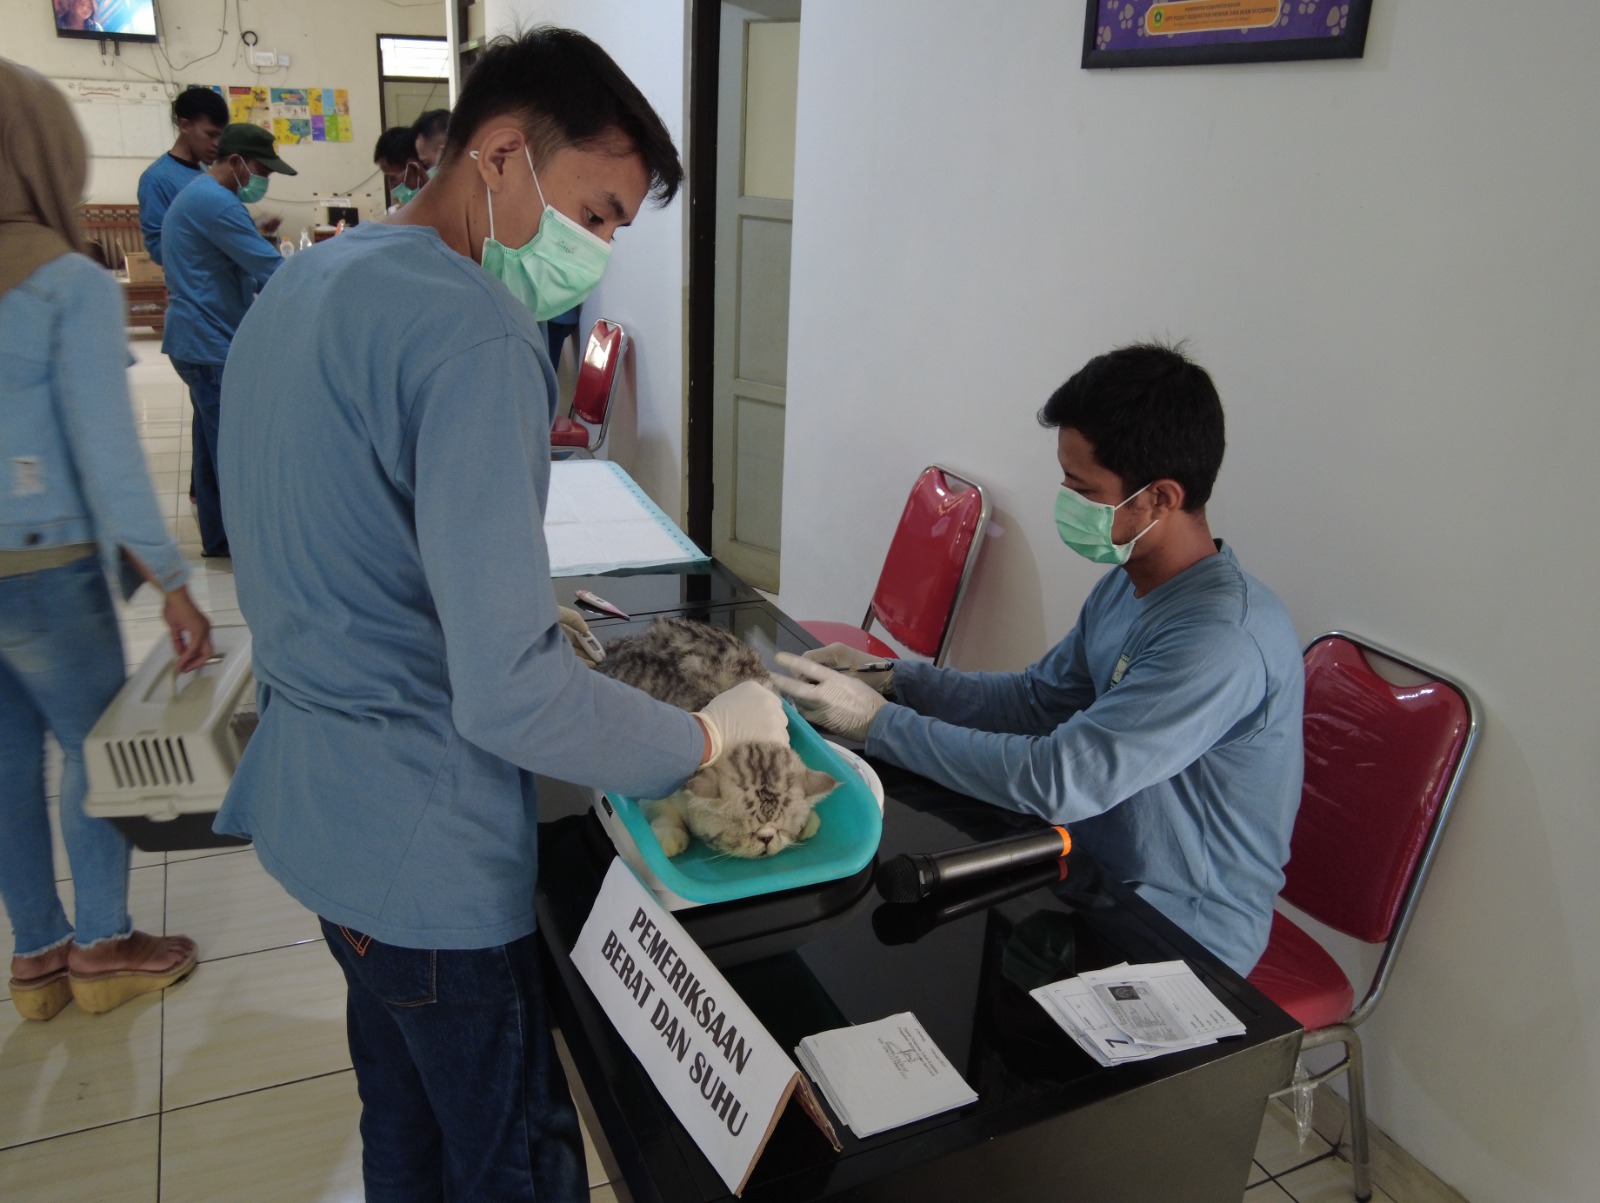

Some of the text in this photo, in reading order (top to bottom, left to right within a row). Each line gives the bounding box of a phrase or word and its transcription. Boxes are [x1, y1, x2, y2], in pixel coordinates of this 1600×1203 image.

[601, 930, 749, 1137] BERAT DAN SUHU
[629, 907, 752, 1076] PEMERIKSAAN
